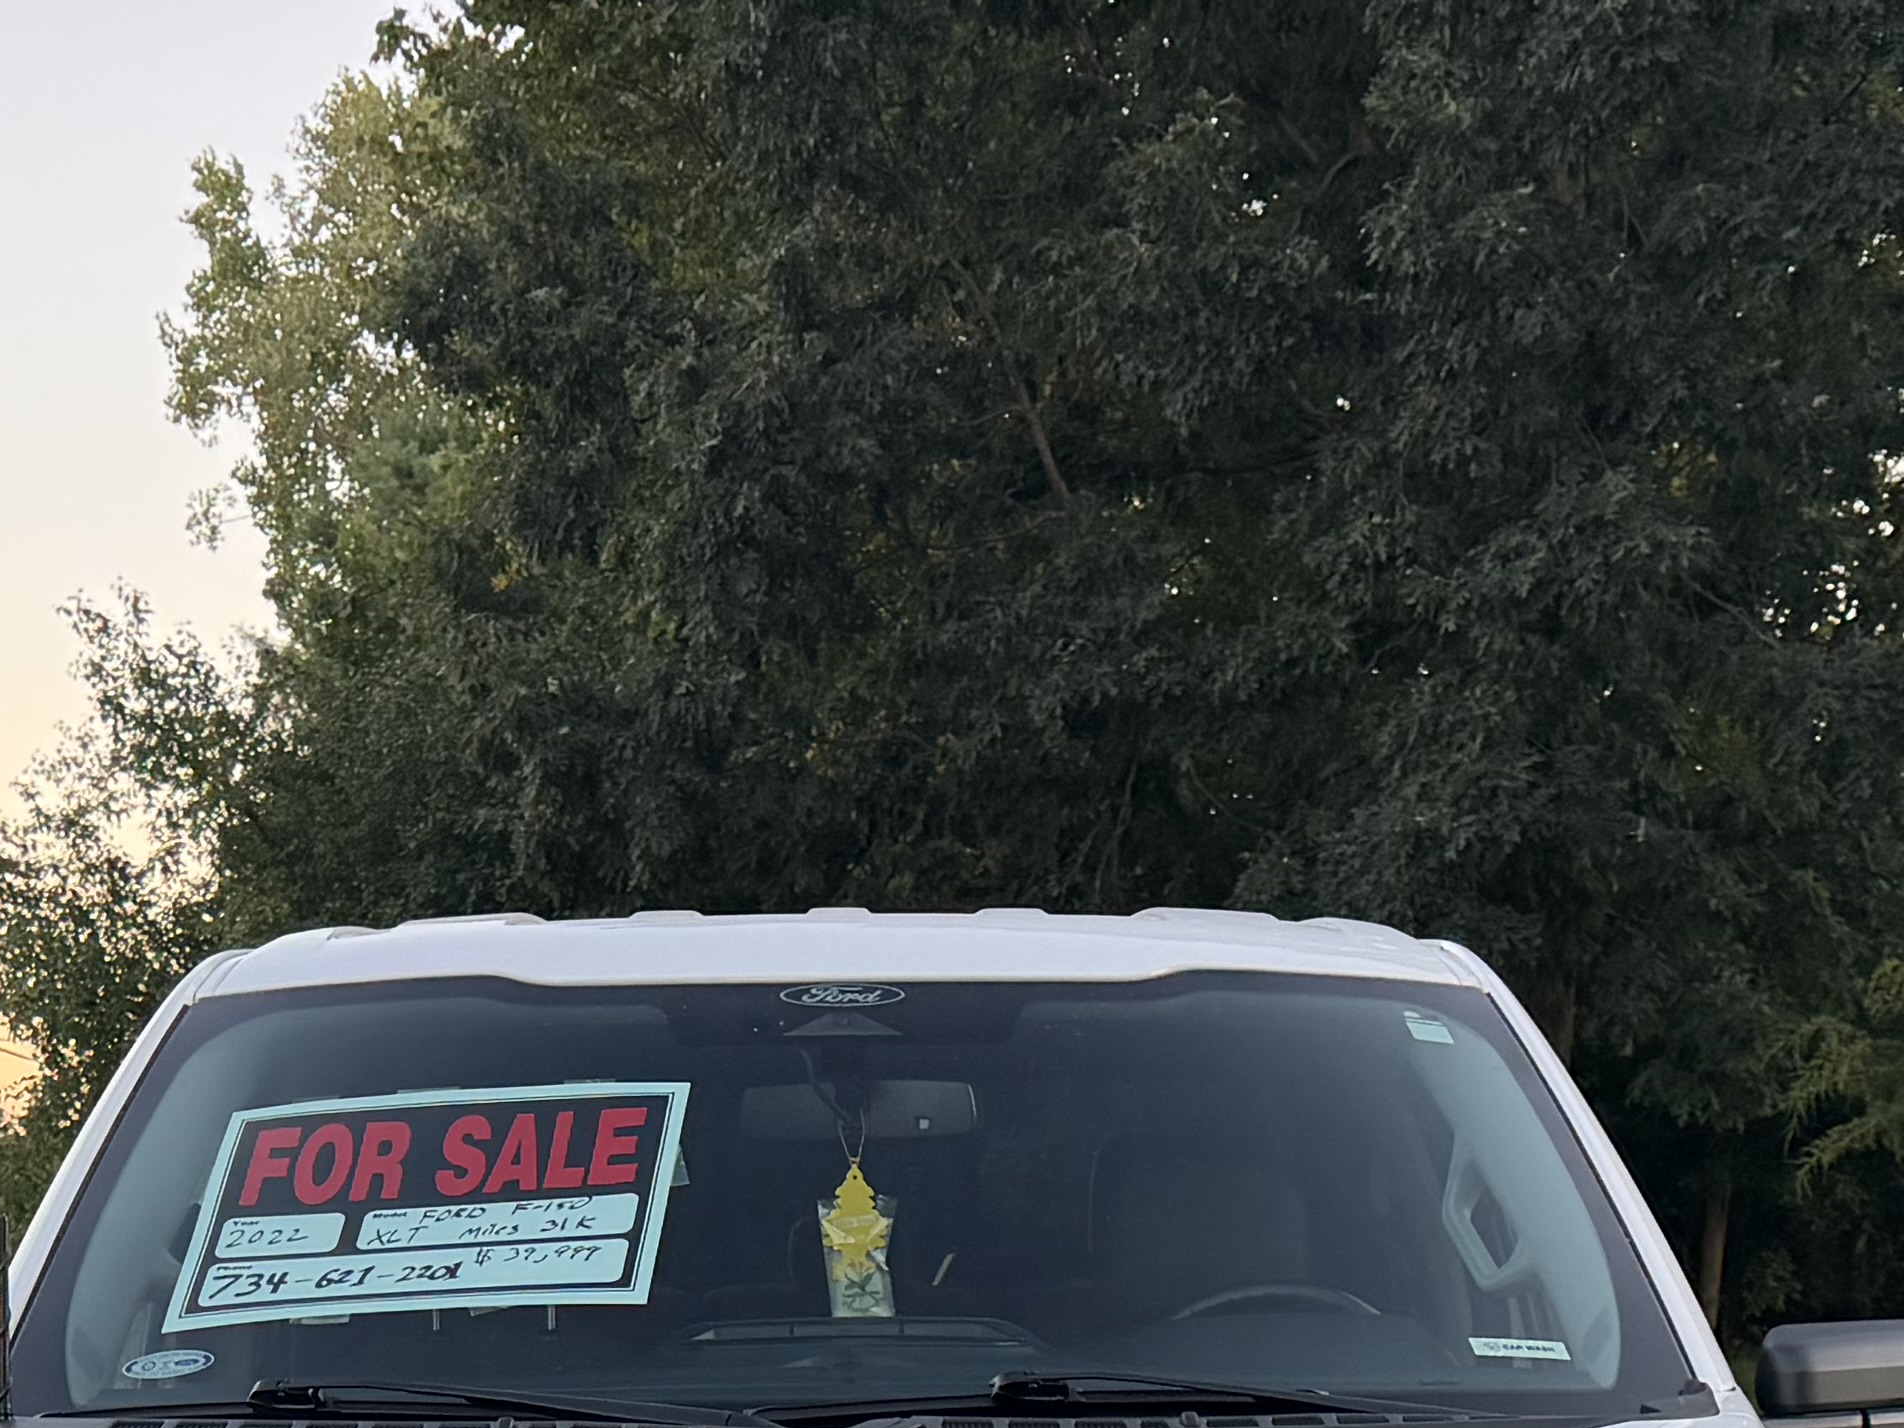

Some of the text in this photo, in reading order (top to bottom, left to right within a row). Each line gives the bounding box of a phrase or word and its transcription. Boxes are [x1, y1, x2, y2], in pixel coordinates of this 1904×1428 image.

[801, 985, 882, 1003] Ford
[238, 1107, 648, 1207] FOR SALE
[418, 1196, 593, 1225] FORD F-150
[224, 1228, 309, 1249] 2022
[366, 1225, 429, 1247] XLT
